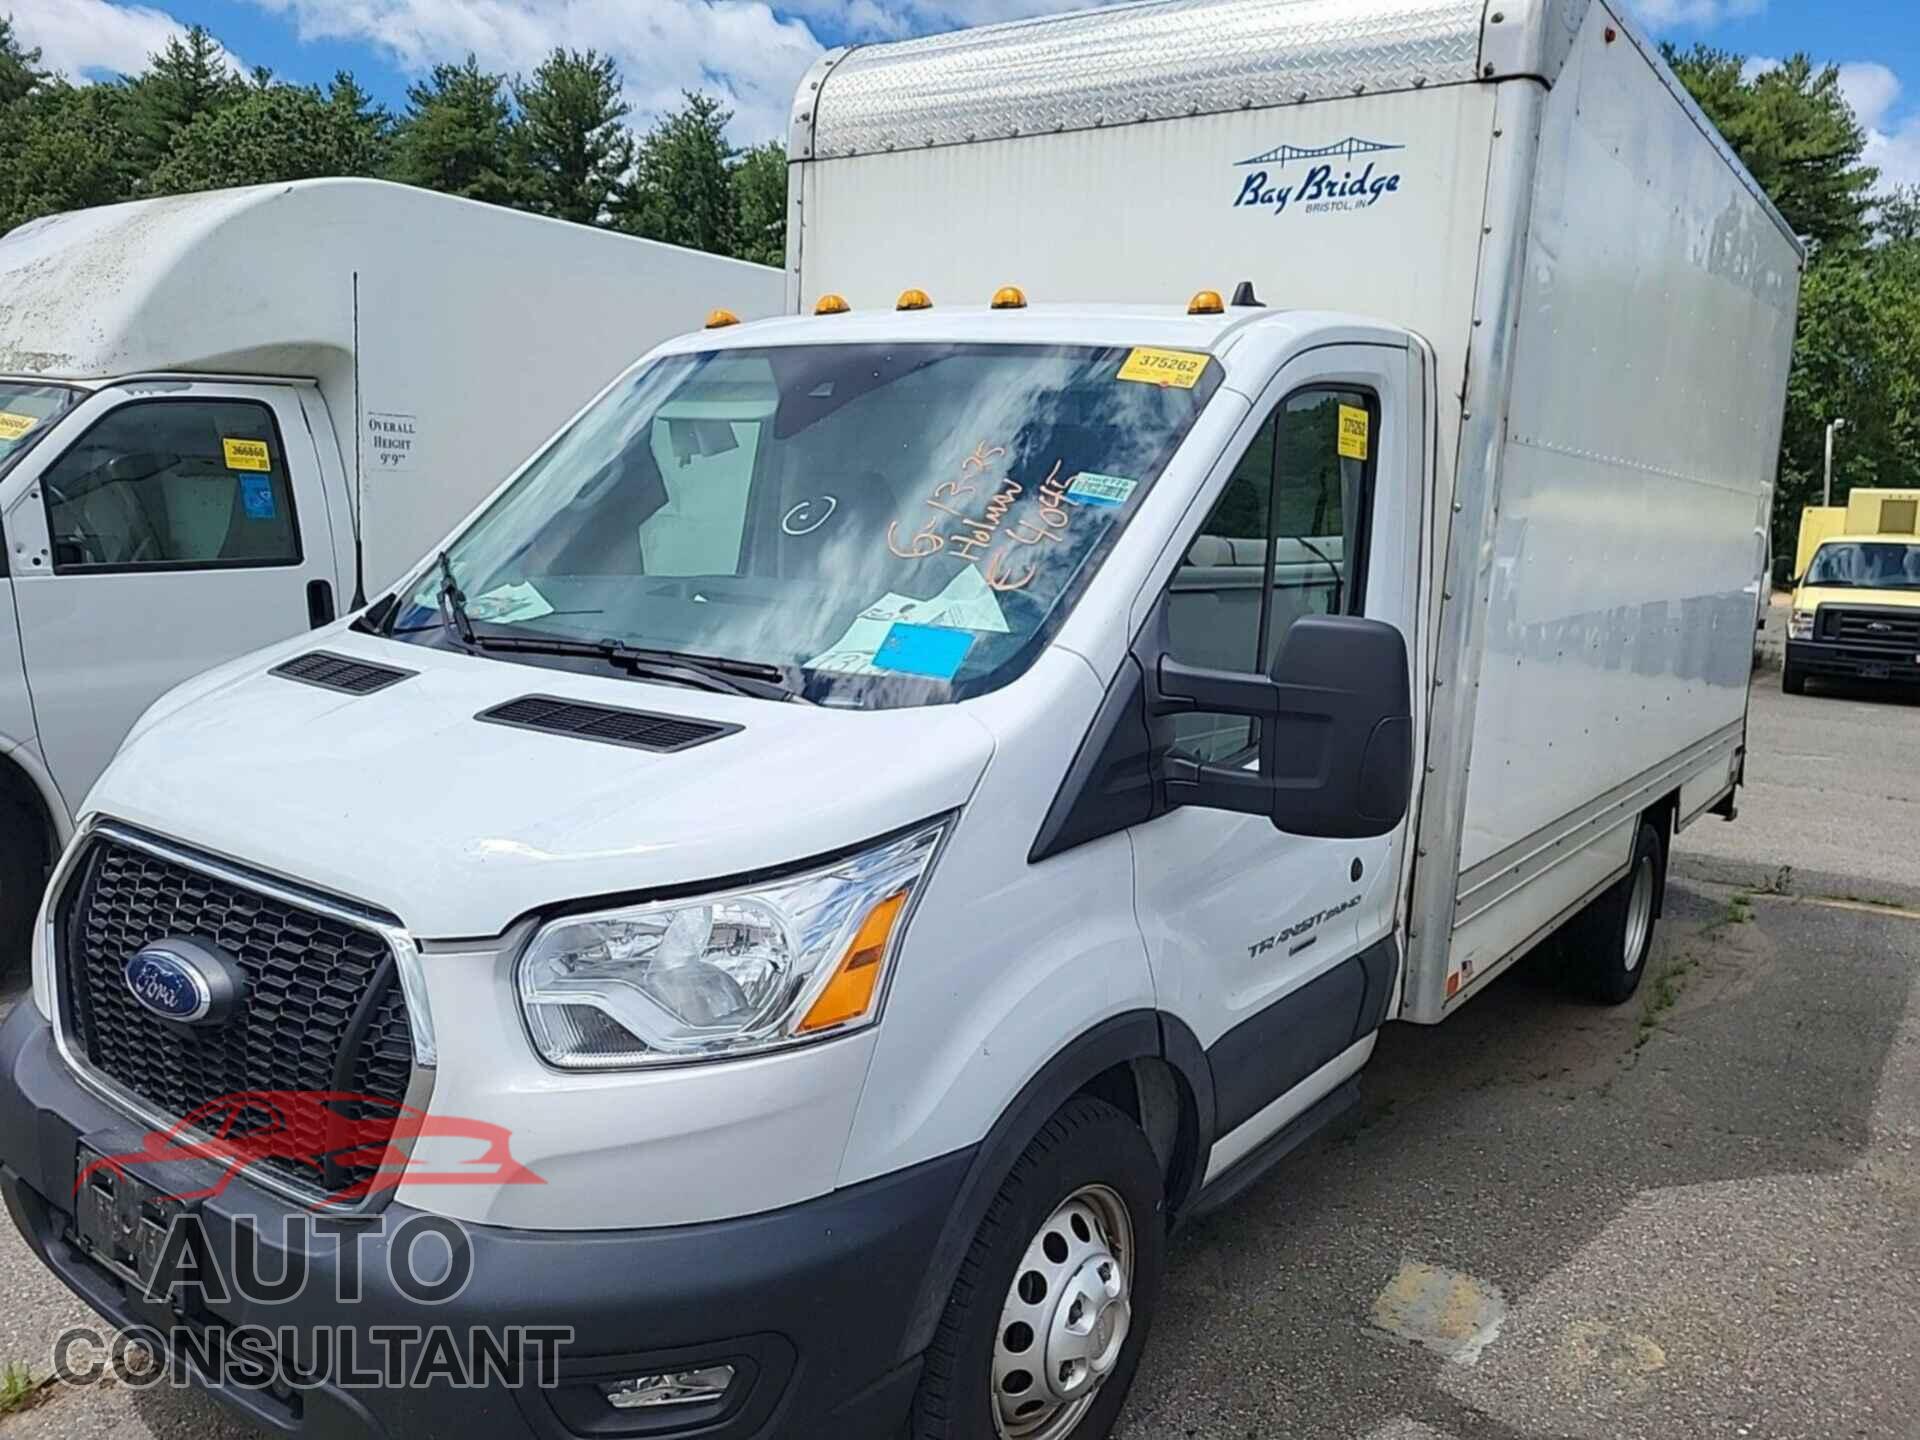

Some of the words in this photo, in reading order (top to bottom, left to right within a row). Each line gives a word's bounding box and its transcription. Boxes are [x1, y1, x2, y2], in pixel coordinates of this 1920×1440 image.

[1233, 170, 1293, 216] Bay
[1294, 162, 1401, 207] Bridge
[1139, 354, 1199, 374] 375262
[368, 419, 417, 434] OVERALL
[373, 435, 412, 450] HEIGHT
[1247, 909, 1327, 958] TRANSIT
[135, 961, 183, 1009] Ford
